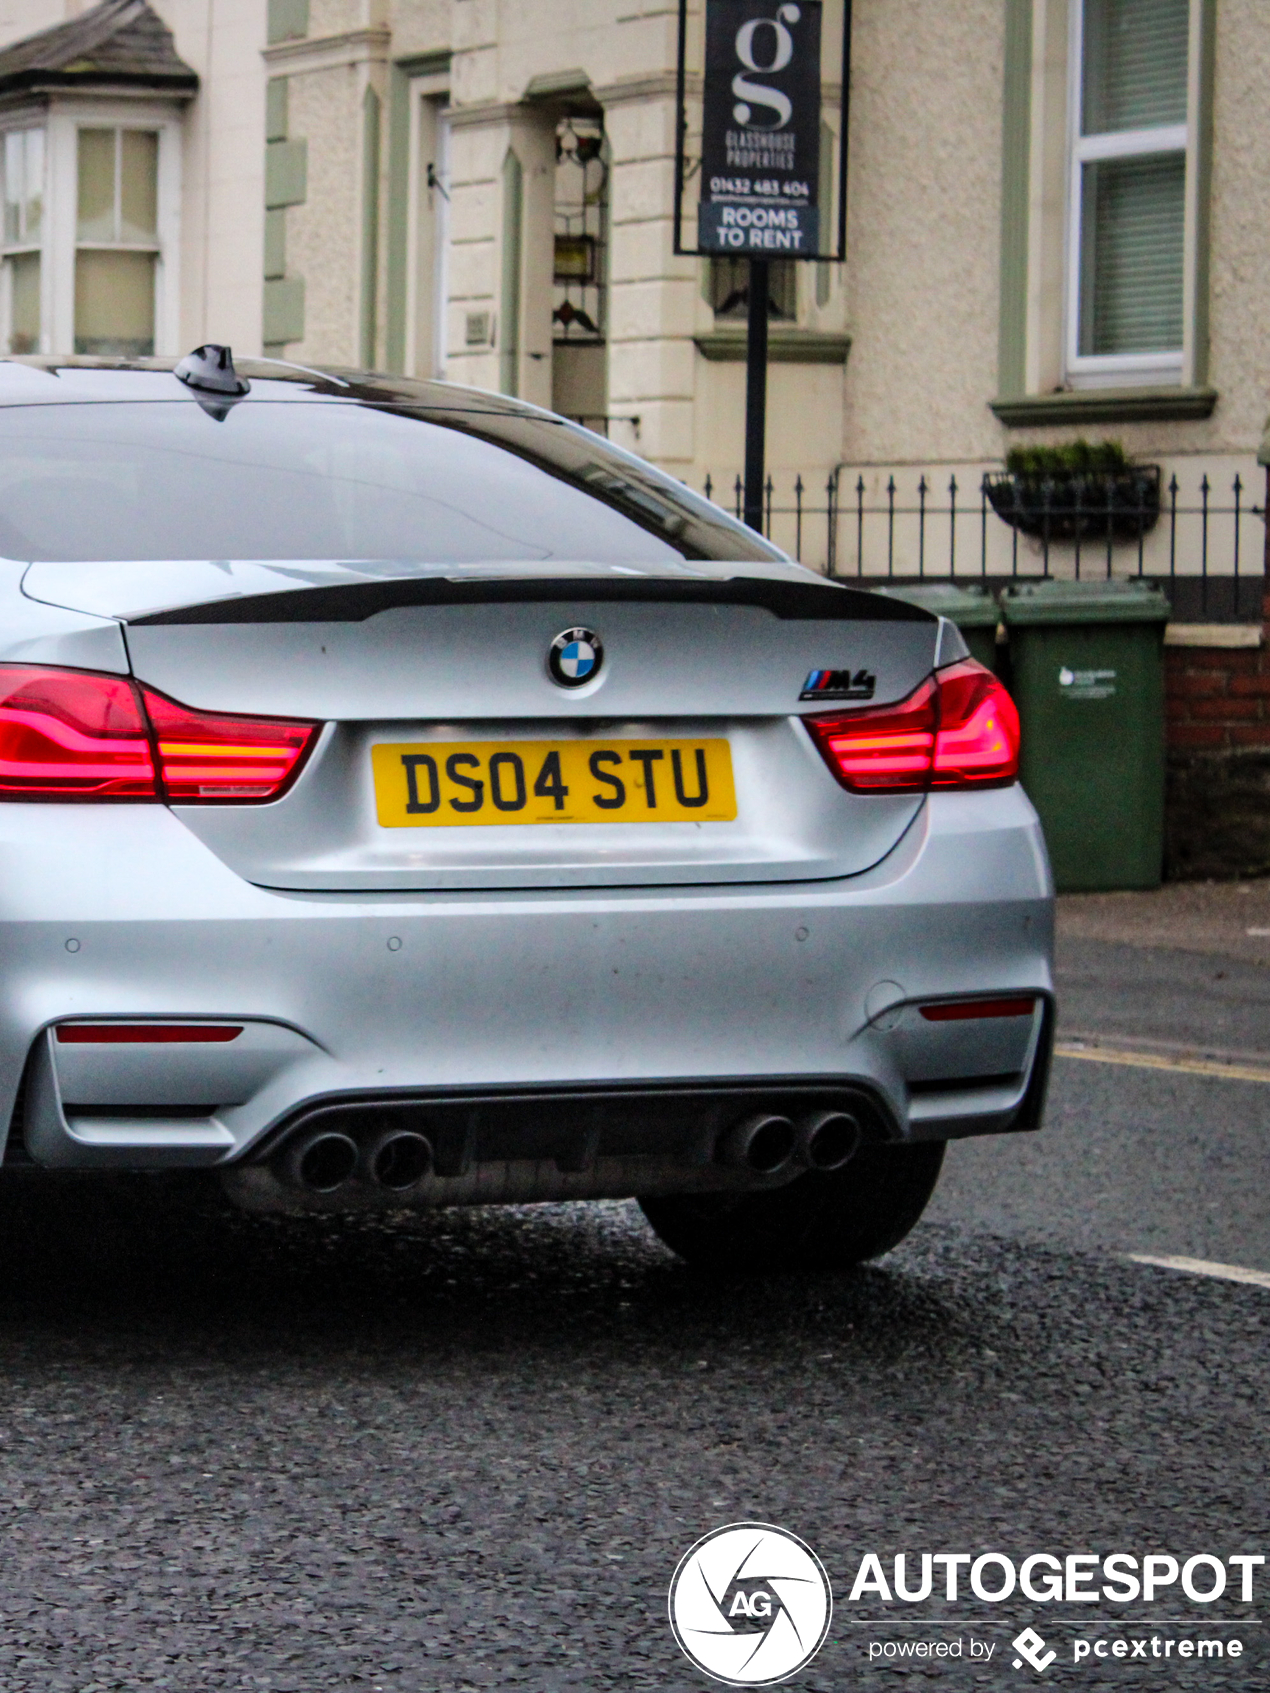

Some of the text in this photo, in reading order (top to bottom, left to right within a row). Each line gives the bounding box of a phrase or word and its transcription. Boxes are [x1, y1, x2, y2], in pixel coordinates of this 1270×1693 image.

[710, 177, 809, 196] 01432 483 404
[722, 206, 798, 229] ROOMS
[717, 226, 803, 248] TO RENT
[589, 748, 709, 809] STU
